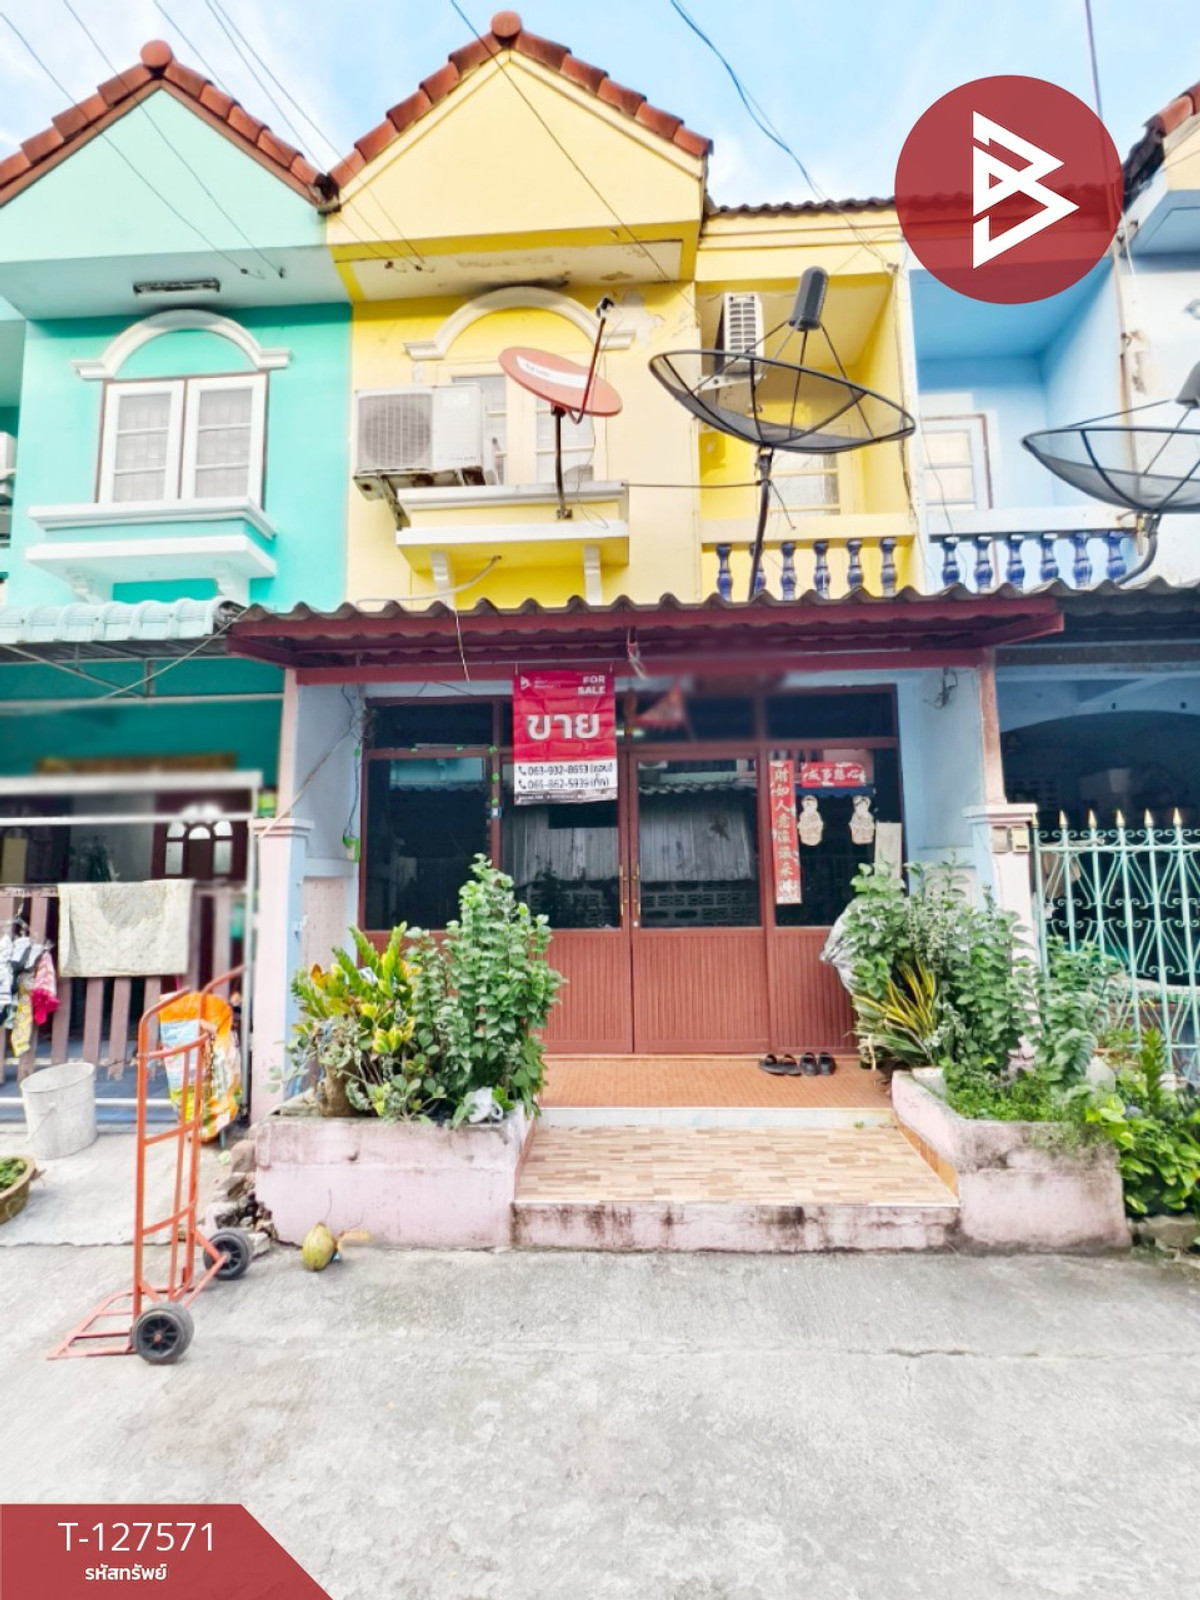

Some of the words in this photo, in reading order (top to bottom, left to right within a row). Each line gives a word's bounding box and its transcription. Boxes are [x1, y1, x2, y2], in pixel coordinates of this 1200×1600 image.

[582, 674, 606, 684] FOR
[577, 685, 606, 695] SALE
[526, 713, 600, 740] ขาย
